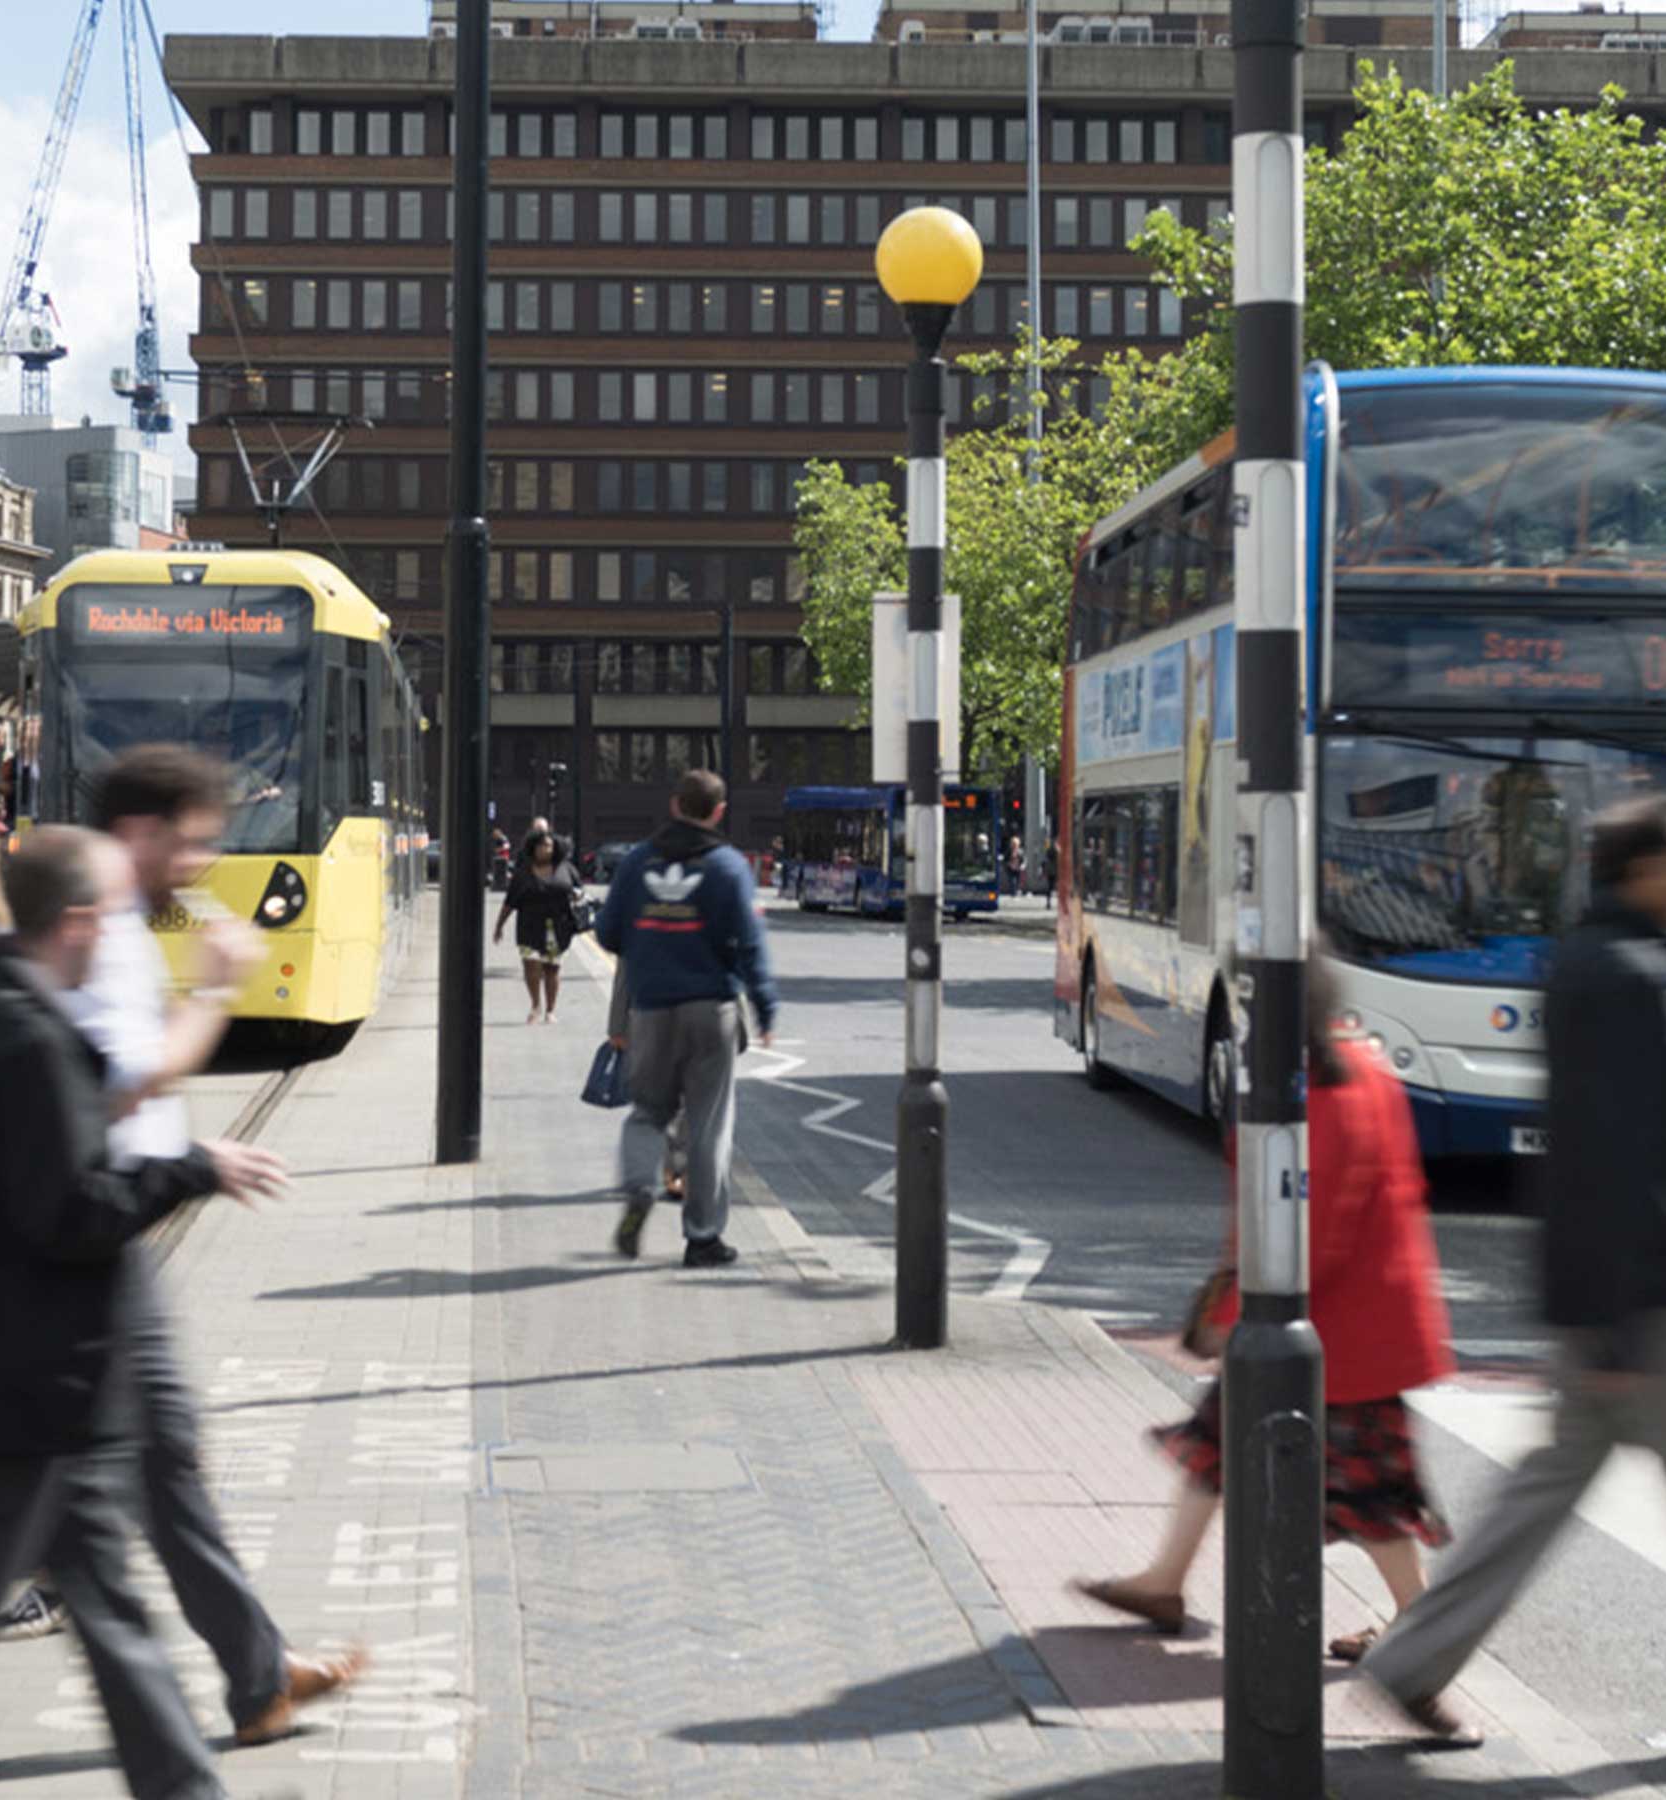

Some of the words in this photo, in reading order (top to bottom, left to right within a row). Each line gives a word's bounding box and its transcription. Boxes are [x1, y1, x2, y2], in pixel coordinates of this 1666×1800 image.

[88, 606, 170, 633] Rochdale
[174, 610, 206, 633] via
[210, 607, 285, 634] Victoria
[1484, 631, 1565, 663] Sorry
[324, 1521, 459, 1612] LEFT
[294, 1633, 459, 1762] LOOK
